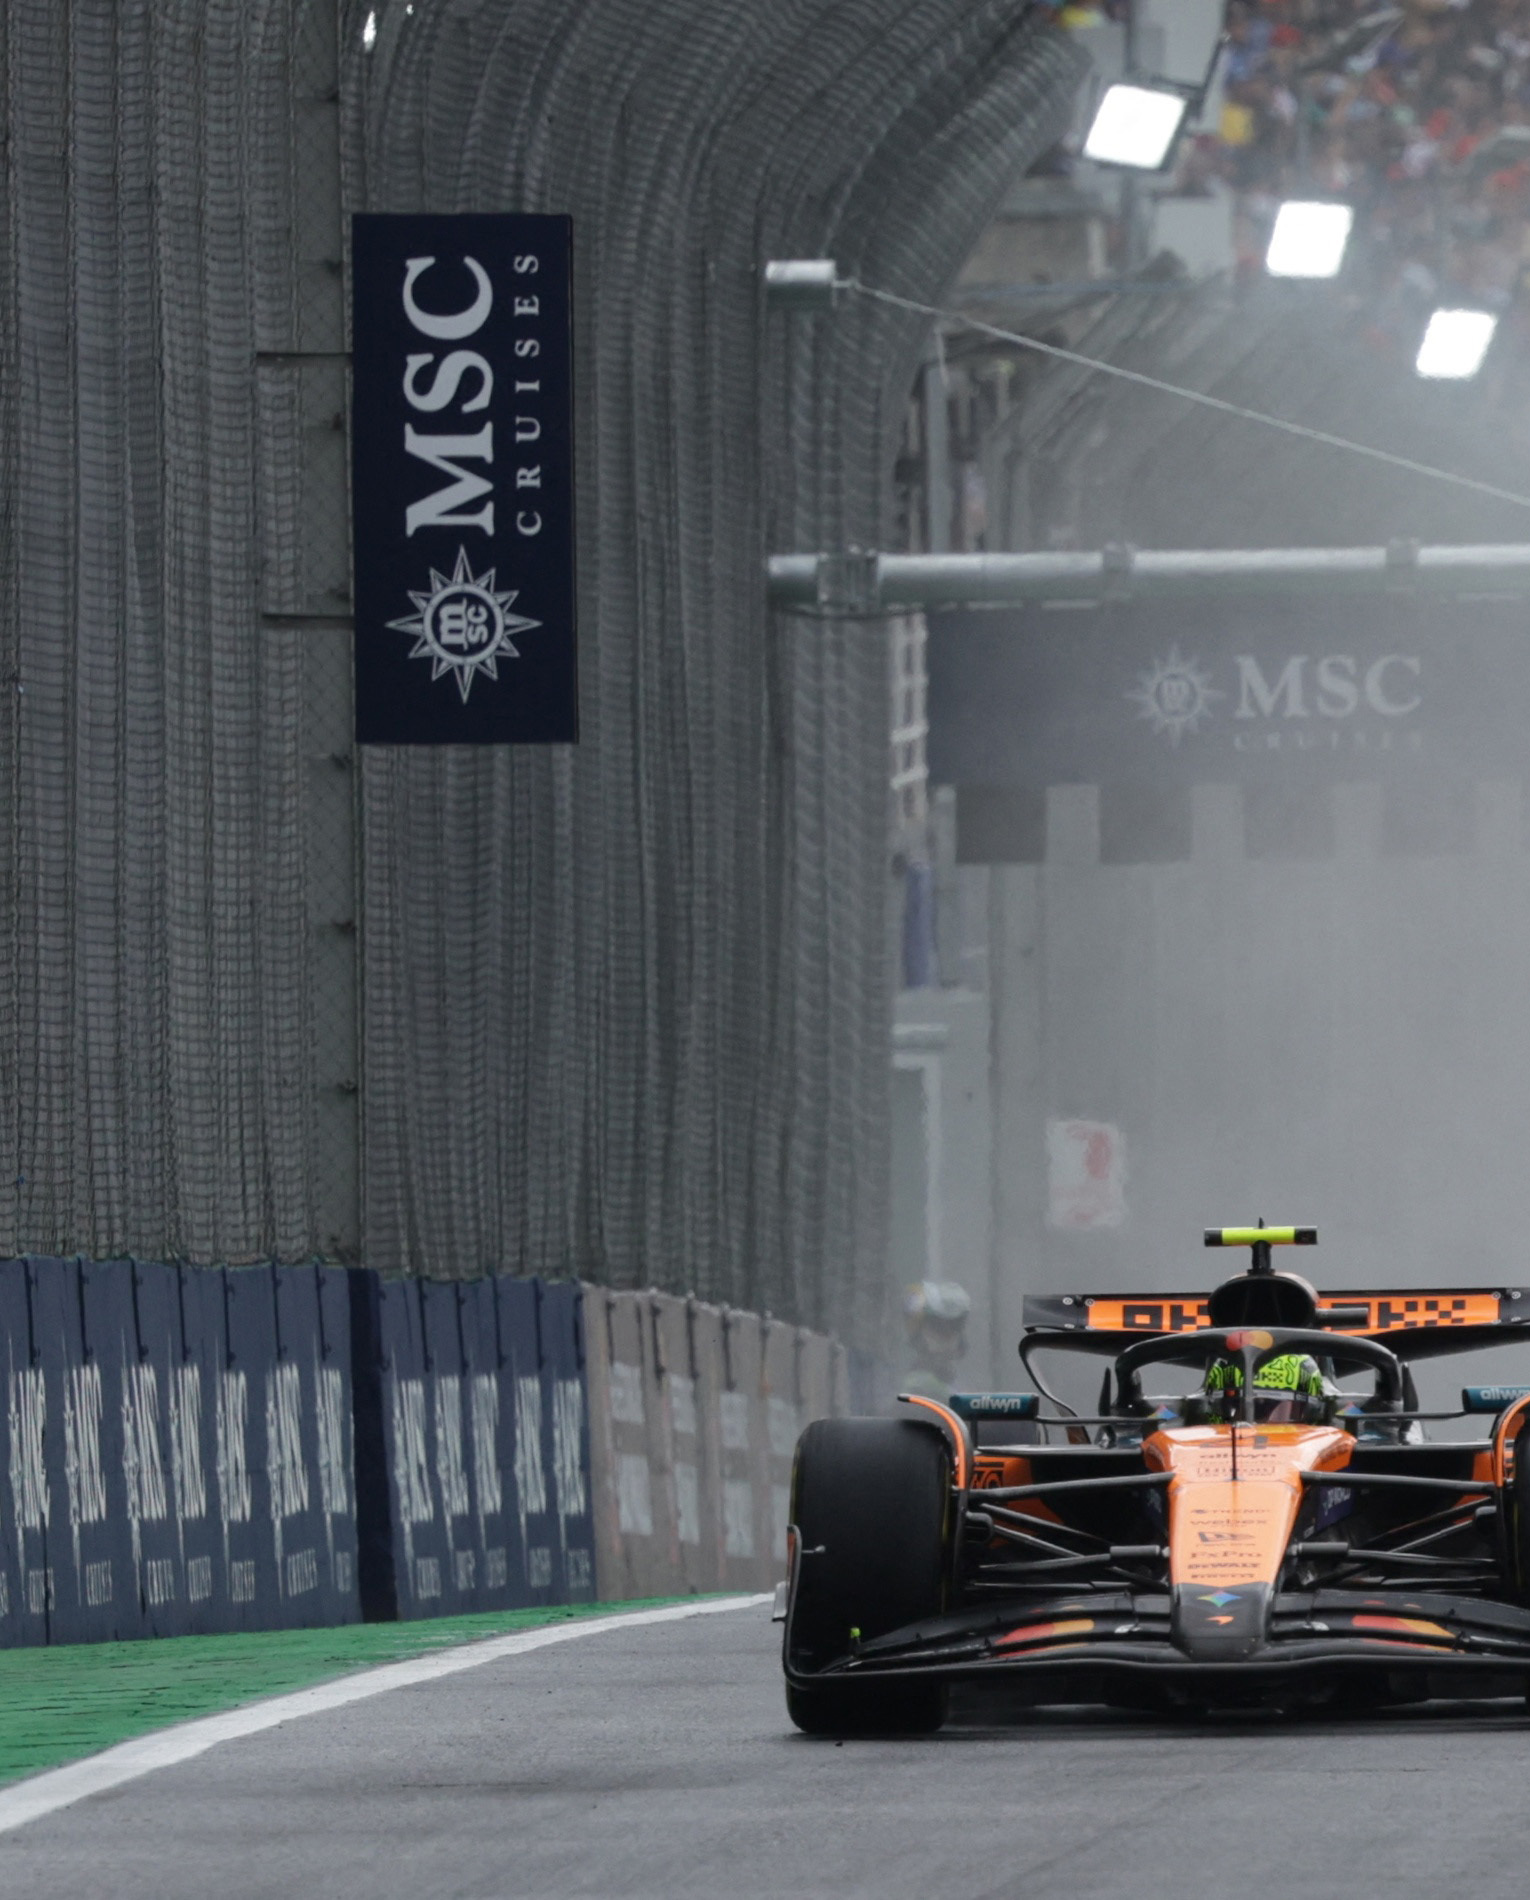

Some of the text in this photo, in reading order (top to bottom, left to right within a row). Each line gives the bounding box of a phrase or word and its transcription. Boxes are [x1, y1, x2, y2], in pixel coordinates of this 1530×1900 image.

[402, 255, 494, 537] MSC
[513, 253, 542, 536] CRUISES
[1235, 655, 1422, 718] MSC
[969, 1396, 1021, 1413] allwyn
